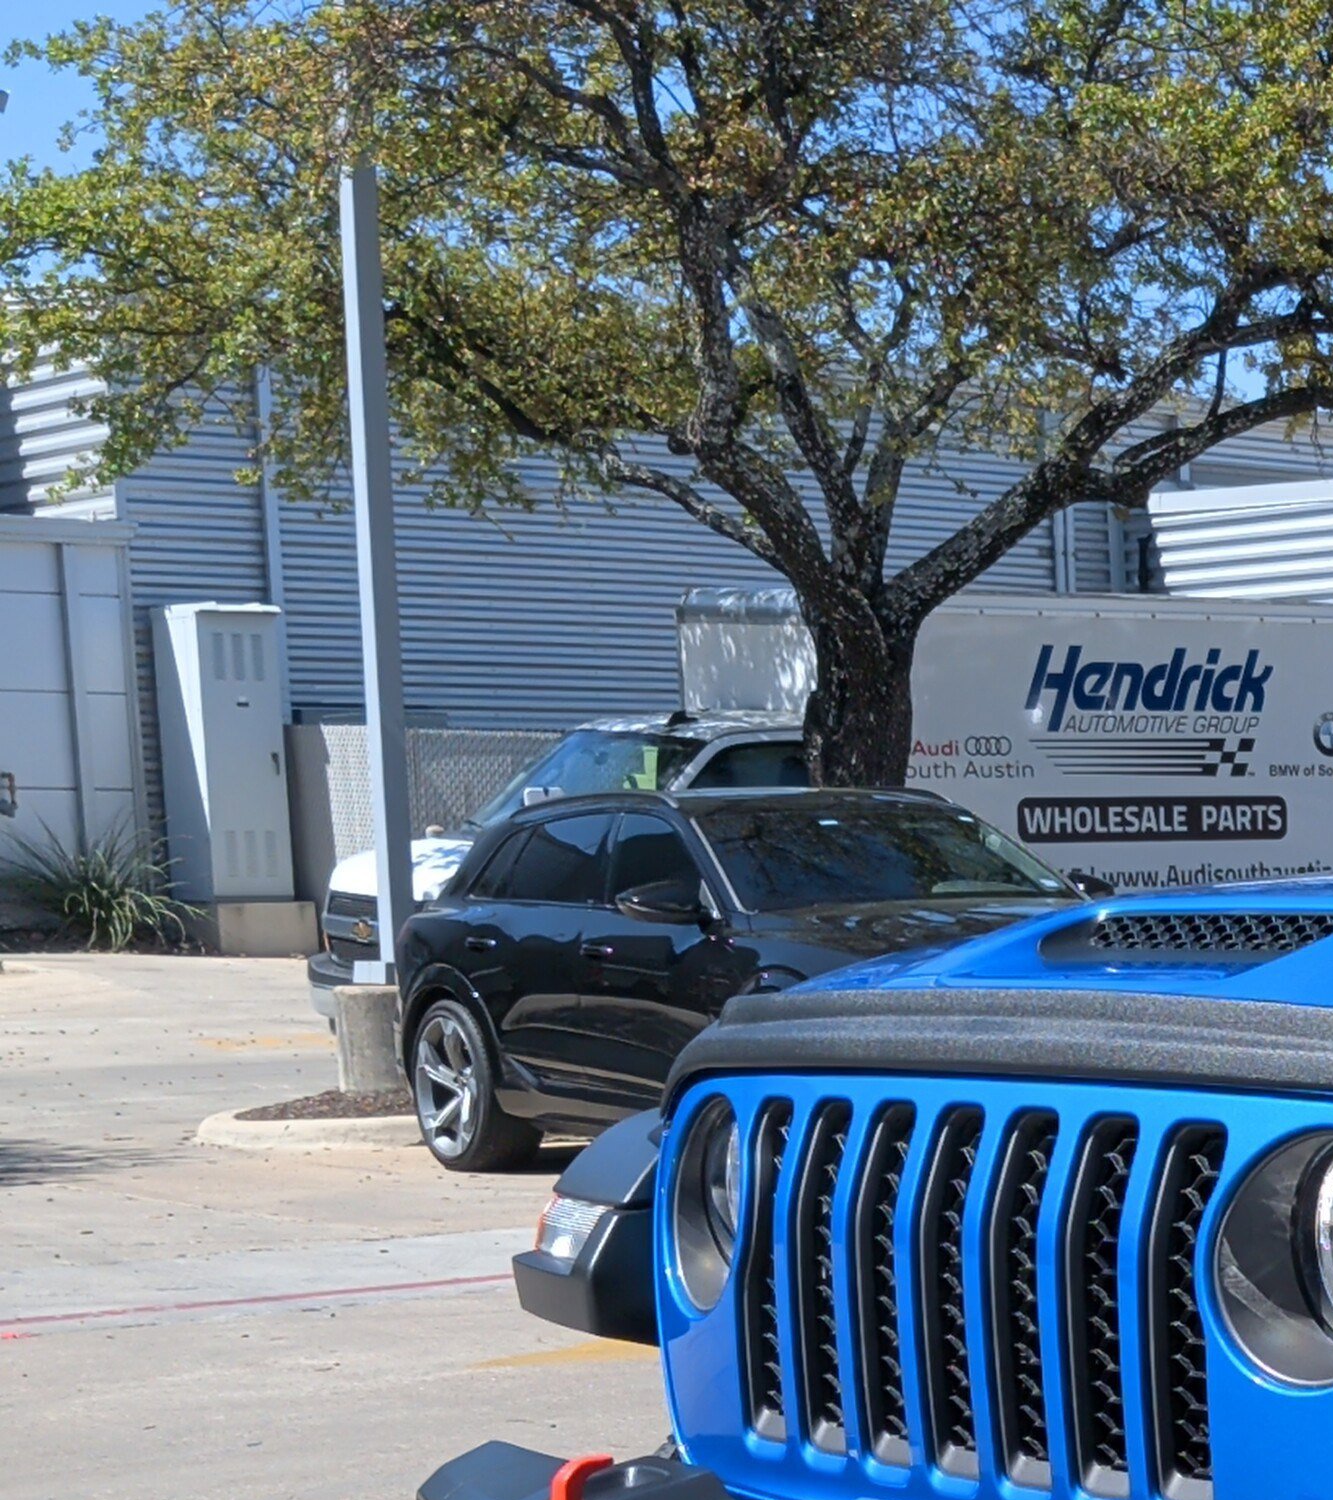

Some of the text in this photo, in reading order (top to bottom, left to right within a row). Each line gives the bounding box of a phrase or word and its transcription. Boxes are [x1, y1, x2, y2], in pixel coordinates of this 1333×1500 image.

[1025, 644, 1274, 732] Hendrick
[1063, 715, 1260, 735] AUTOMOTIVE GROUP
[911, 740, 960, 756] Audi
[905, 760, 1035, 779] outh Austin
[1269, 764, 1300, 777] BMW
[1303, 764, 1315, 777] of
[1023, 804, 1283, 834] WHOLESALE PARTS
